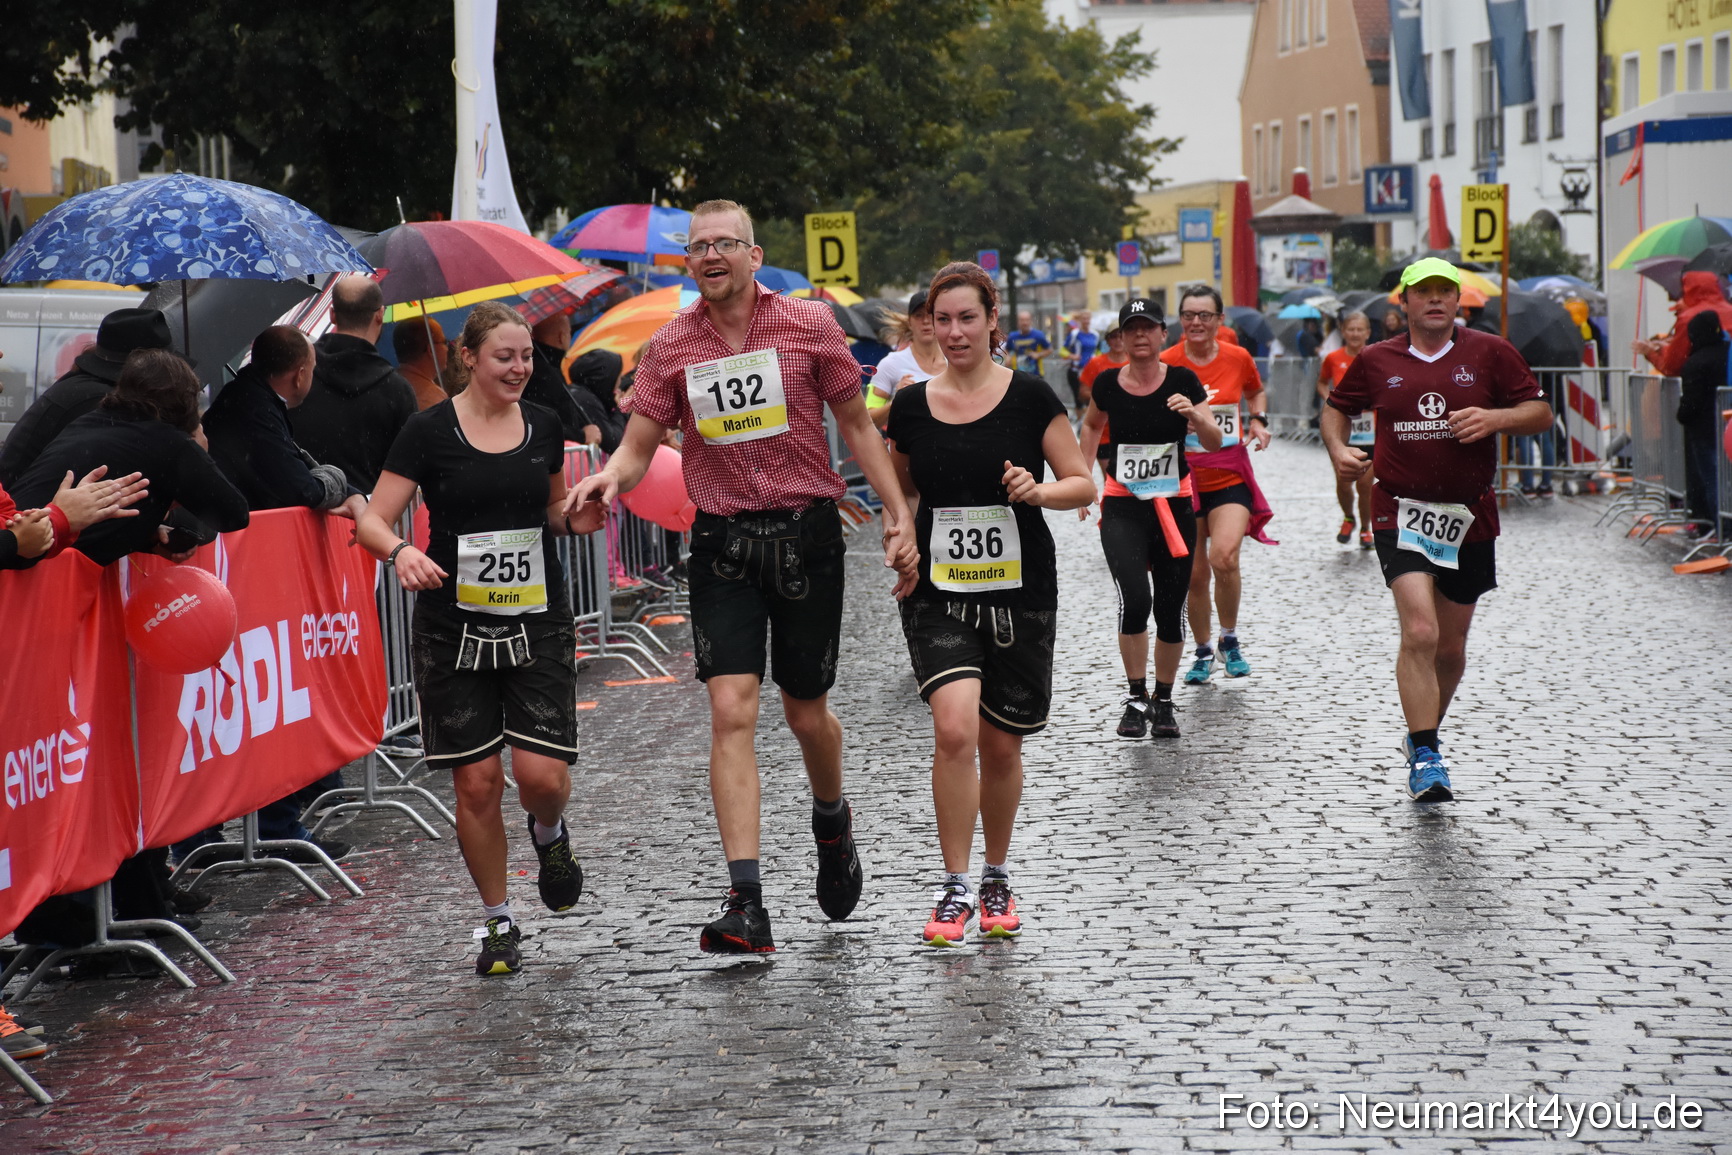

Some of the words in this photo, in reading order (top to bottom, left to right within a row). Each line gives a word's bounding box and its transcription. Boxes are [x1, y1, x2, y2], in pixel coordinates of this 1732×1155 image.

[1467, 187, 1504, 201] Block
[811, 216, 849, 230] Block
[1474, 208, 1497, 244] D
[820, 236, 845, 271] D
[725, 354, 768, 371] BOCK
[1455, 373, 1474, 382] FCN
[707, 373, 767, 412] 132
[723, 415, 762, 432] Martin
[1394, 419, 1461, 432] NÜRNBER
[1398, 431, 1455, 441] VERSICHERU
[1123, 454, 1173, 480] 3057
[968, 509, 1008, 520] BOCK
[1406, 507, 1464, 542] 2636
[501, 531, 539, 544] BOCK
[948, 526, 1003, 560] 336
[477, 550, 532, 583] 255
[947, 566, 1005, 580] Alexandra
[488, 591, 520, 604] Karin
[143, 593, 198, 633] RÖDL
